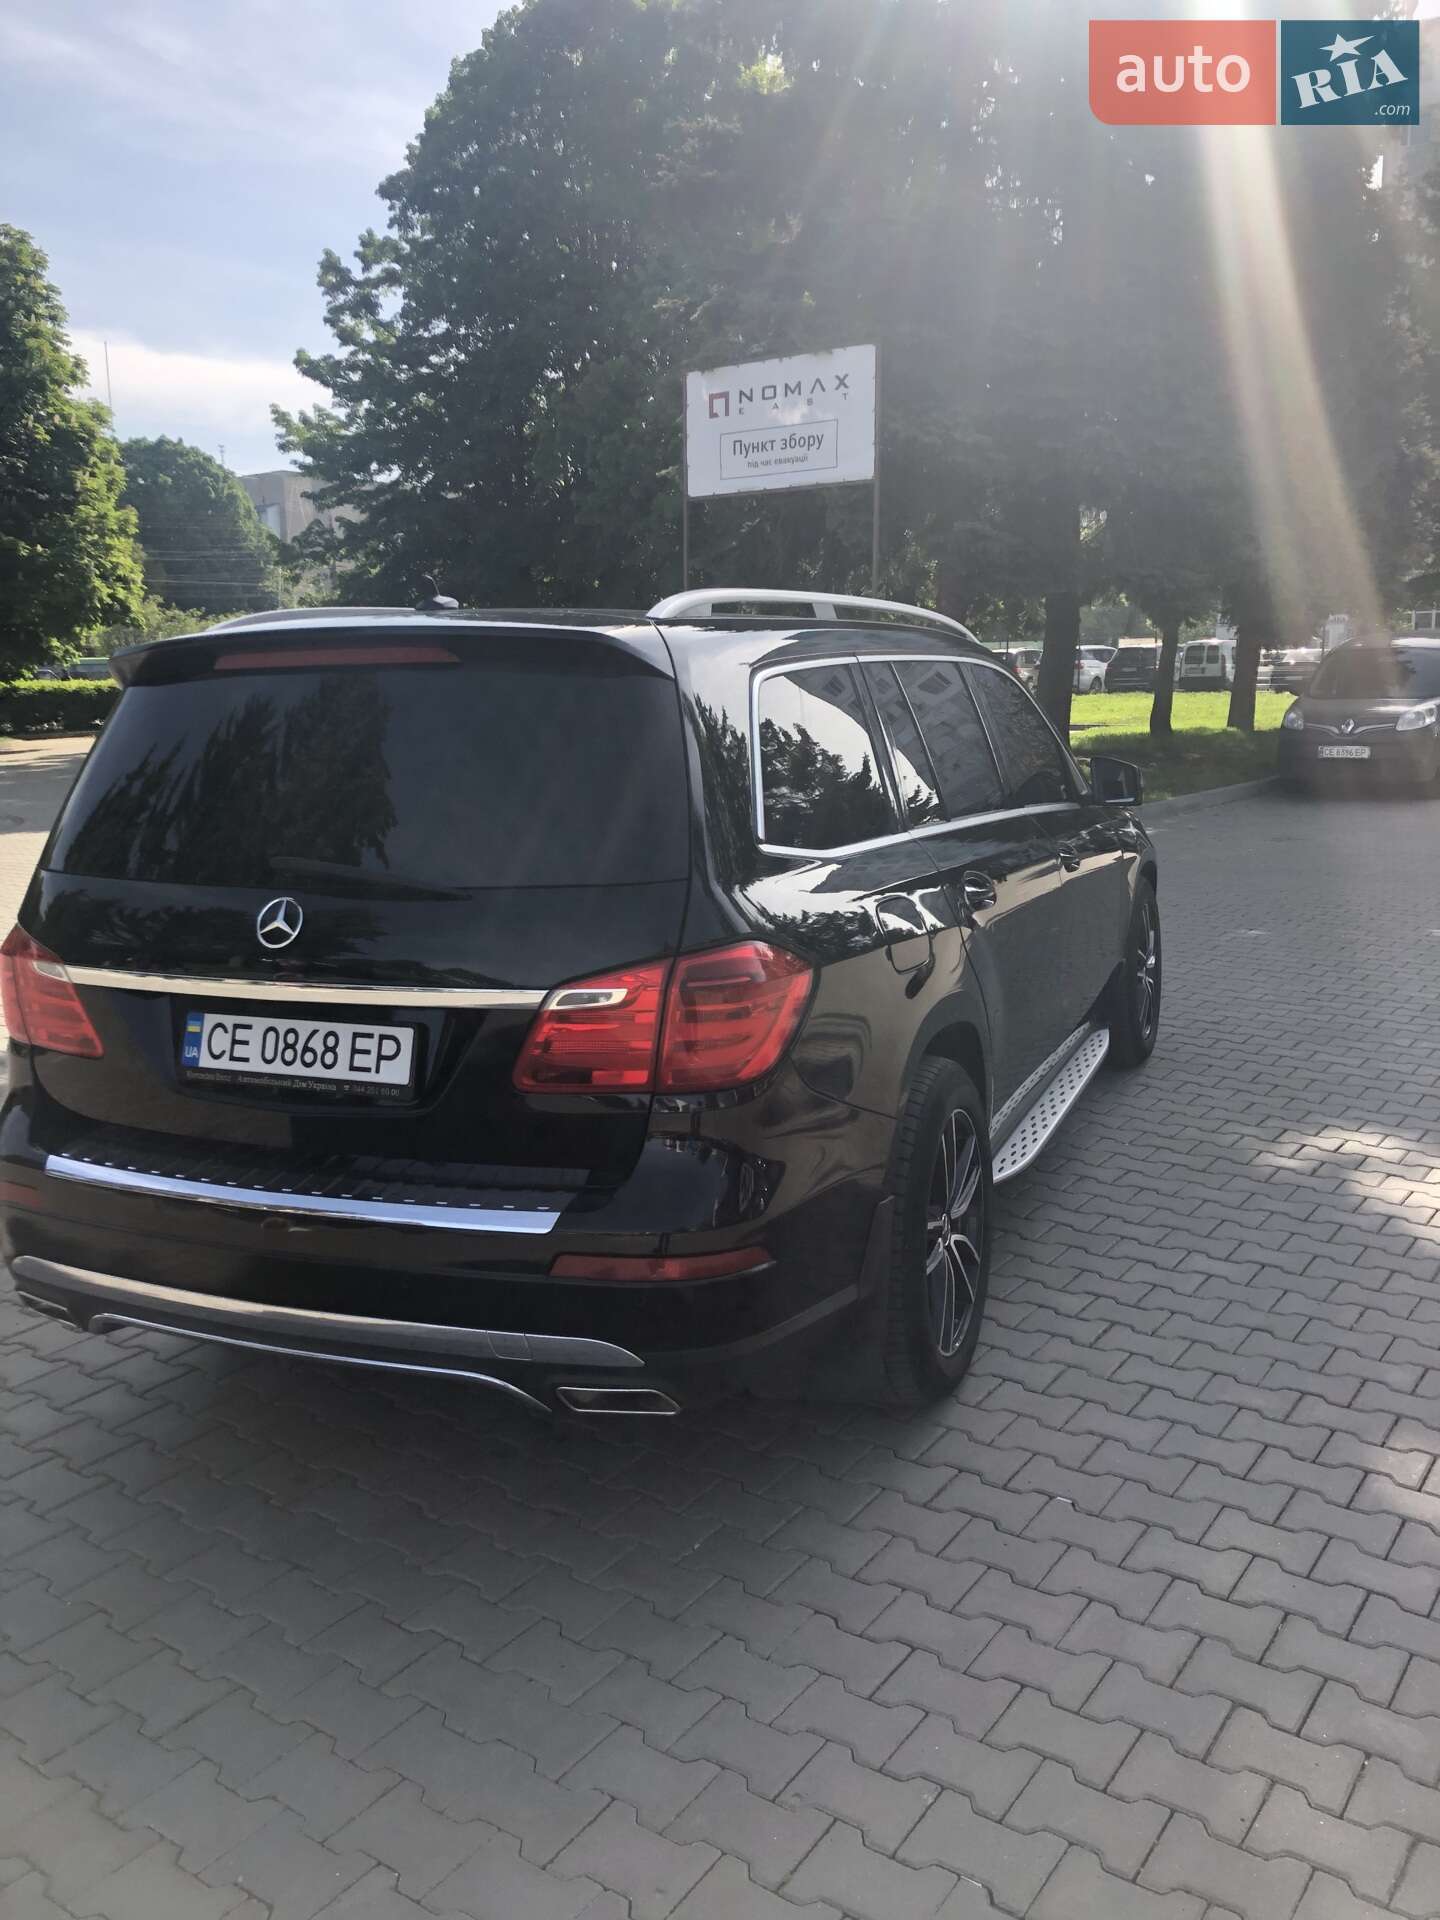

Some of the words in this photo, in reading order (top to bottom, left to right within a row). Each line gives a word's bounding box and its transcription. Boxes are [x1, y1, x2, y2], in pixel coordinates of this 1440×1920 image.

[739, 373, 849, 404] NOMAX
[733, 439, 776, 459] Пункт
[780, 432, 825, 451] збору
[184, 1046, 199, 1058] UA
[207, 1022, 253, 1063] CE
[261, 1026, 340, 1070] 0868
[348, 1031, 402, 1074] EP
